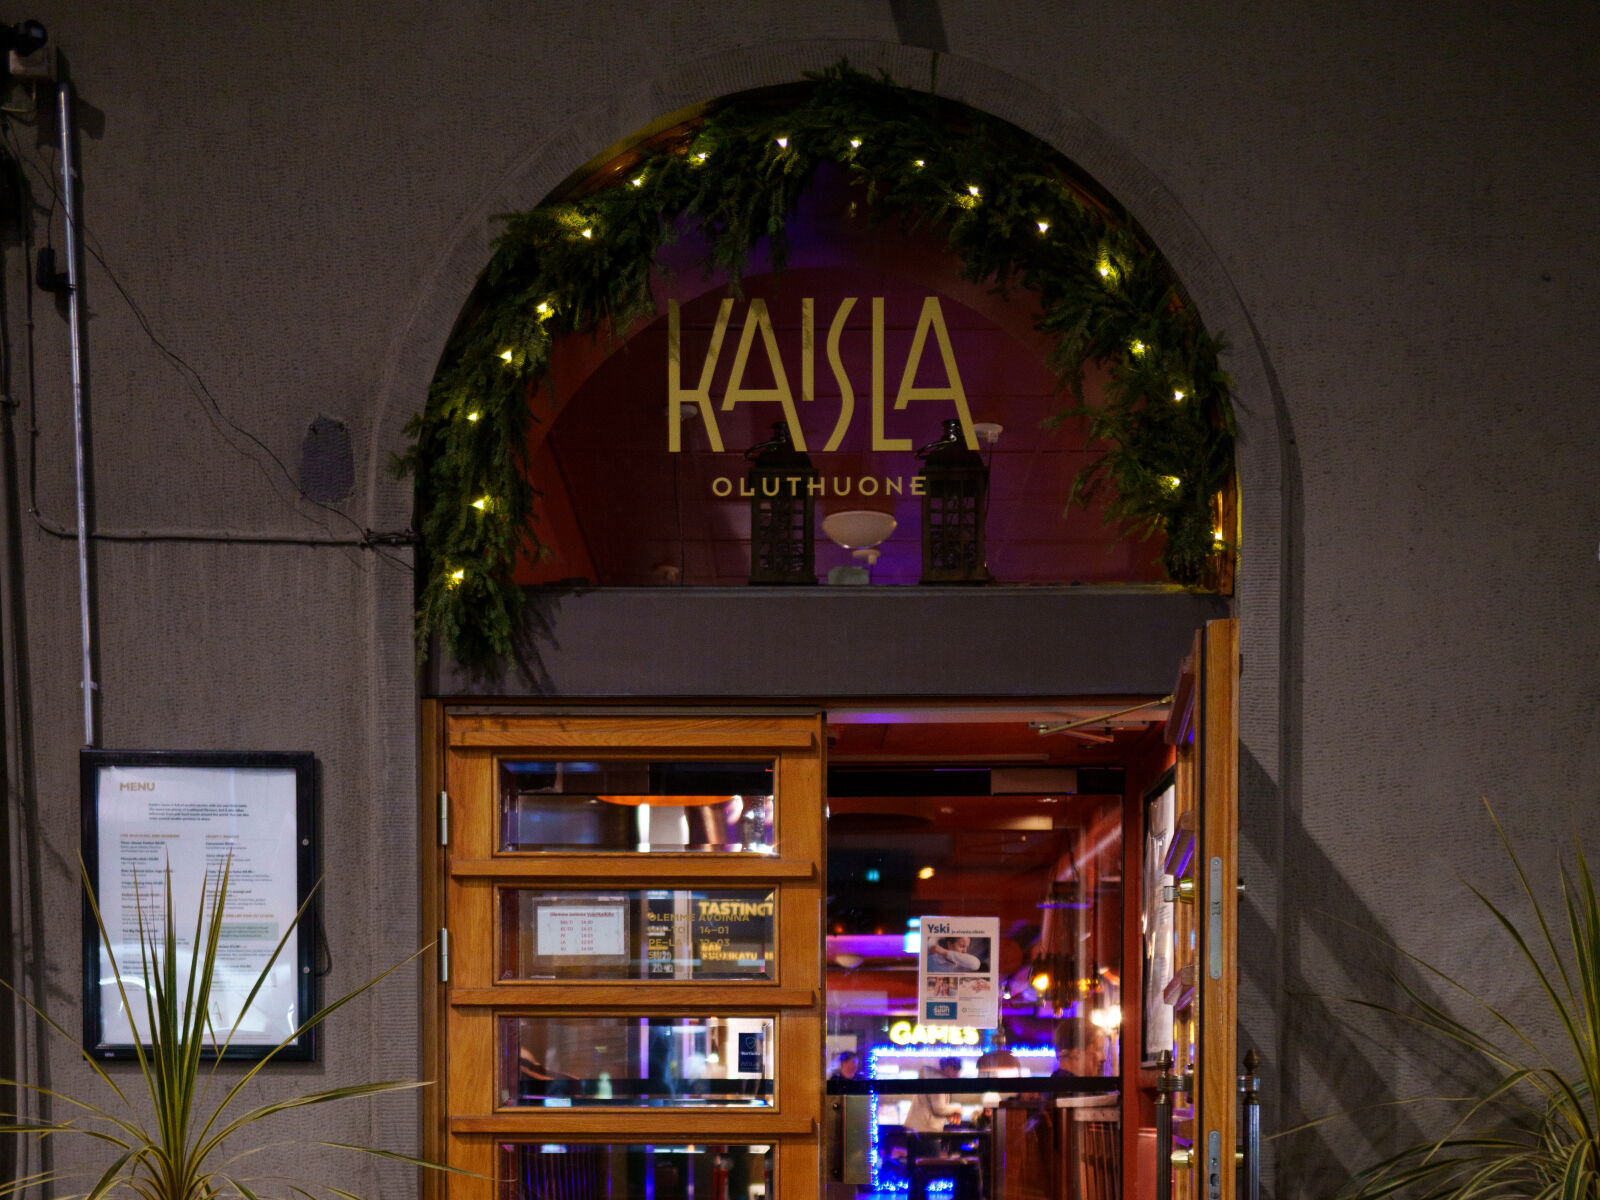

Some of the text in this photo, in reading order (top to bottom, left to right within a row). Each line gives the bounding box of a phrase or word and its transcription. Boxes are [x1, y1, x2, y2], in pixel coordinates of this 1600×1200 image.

[668, 296, 981, 453] KAISLA
[712, 475, 928, 497] OLUTHUONE
[119, 782, 156, 792] MENU
[648, 912, 696, 922] OLEMME
[927, 923, 950, 934] Yski
[889, 1021, 980, 1046] GAMES
